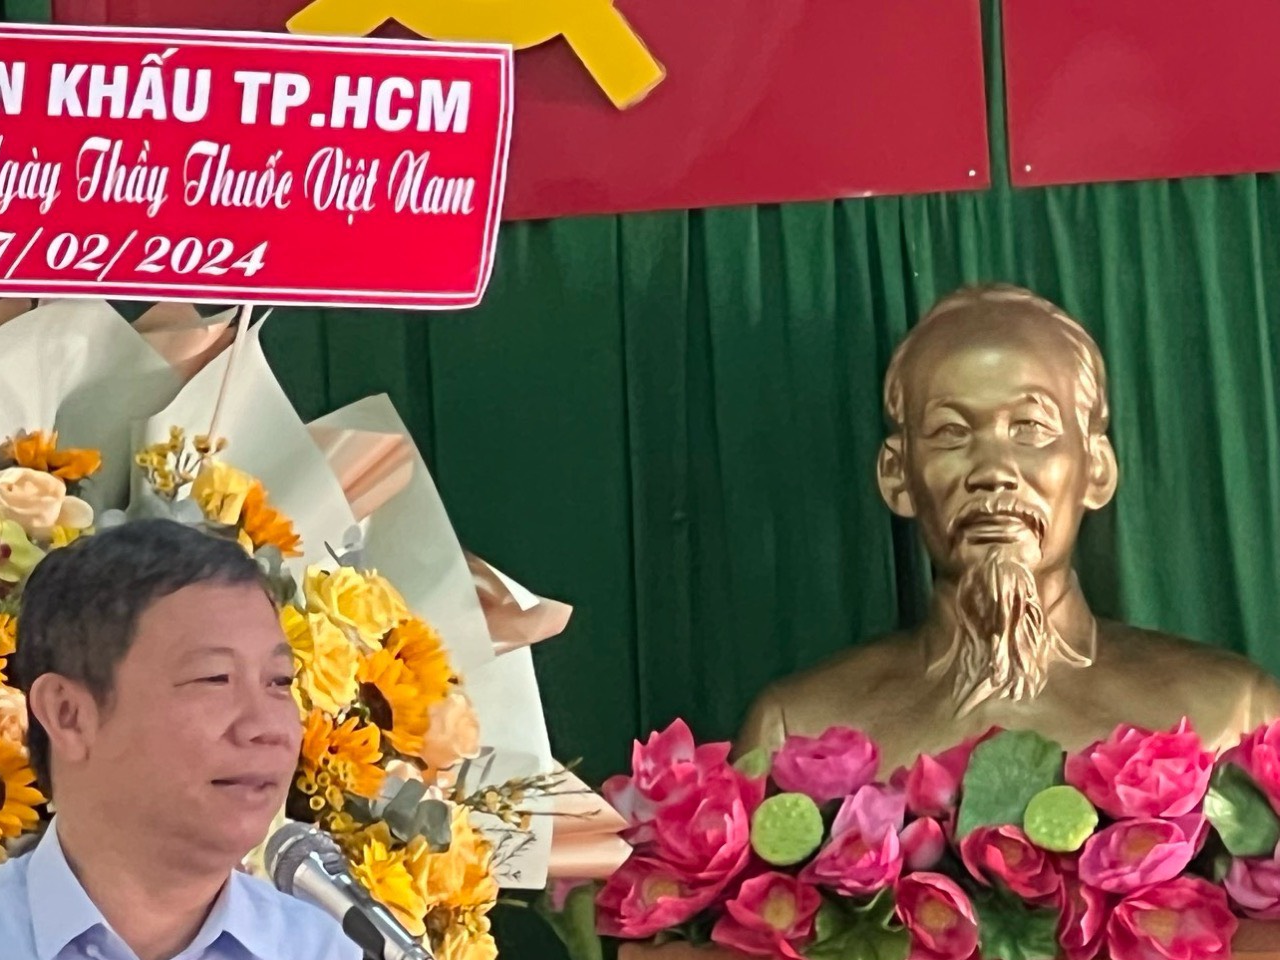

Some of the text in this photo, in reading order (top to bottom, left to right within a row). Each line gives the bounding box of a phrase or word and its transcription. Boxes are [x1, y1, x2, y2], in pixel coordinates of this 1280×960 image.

[47, 47, 212, 123] KHẤU
[233, 70, 472, 134] TP.HCM
[76, 136, 169, 218] Thầy
[183, 140, 293, 210] Thuốc
[303, 146, 380, 226] Việt
[387, 149, 475, 215] Nam
